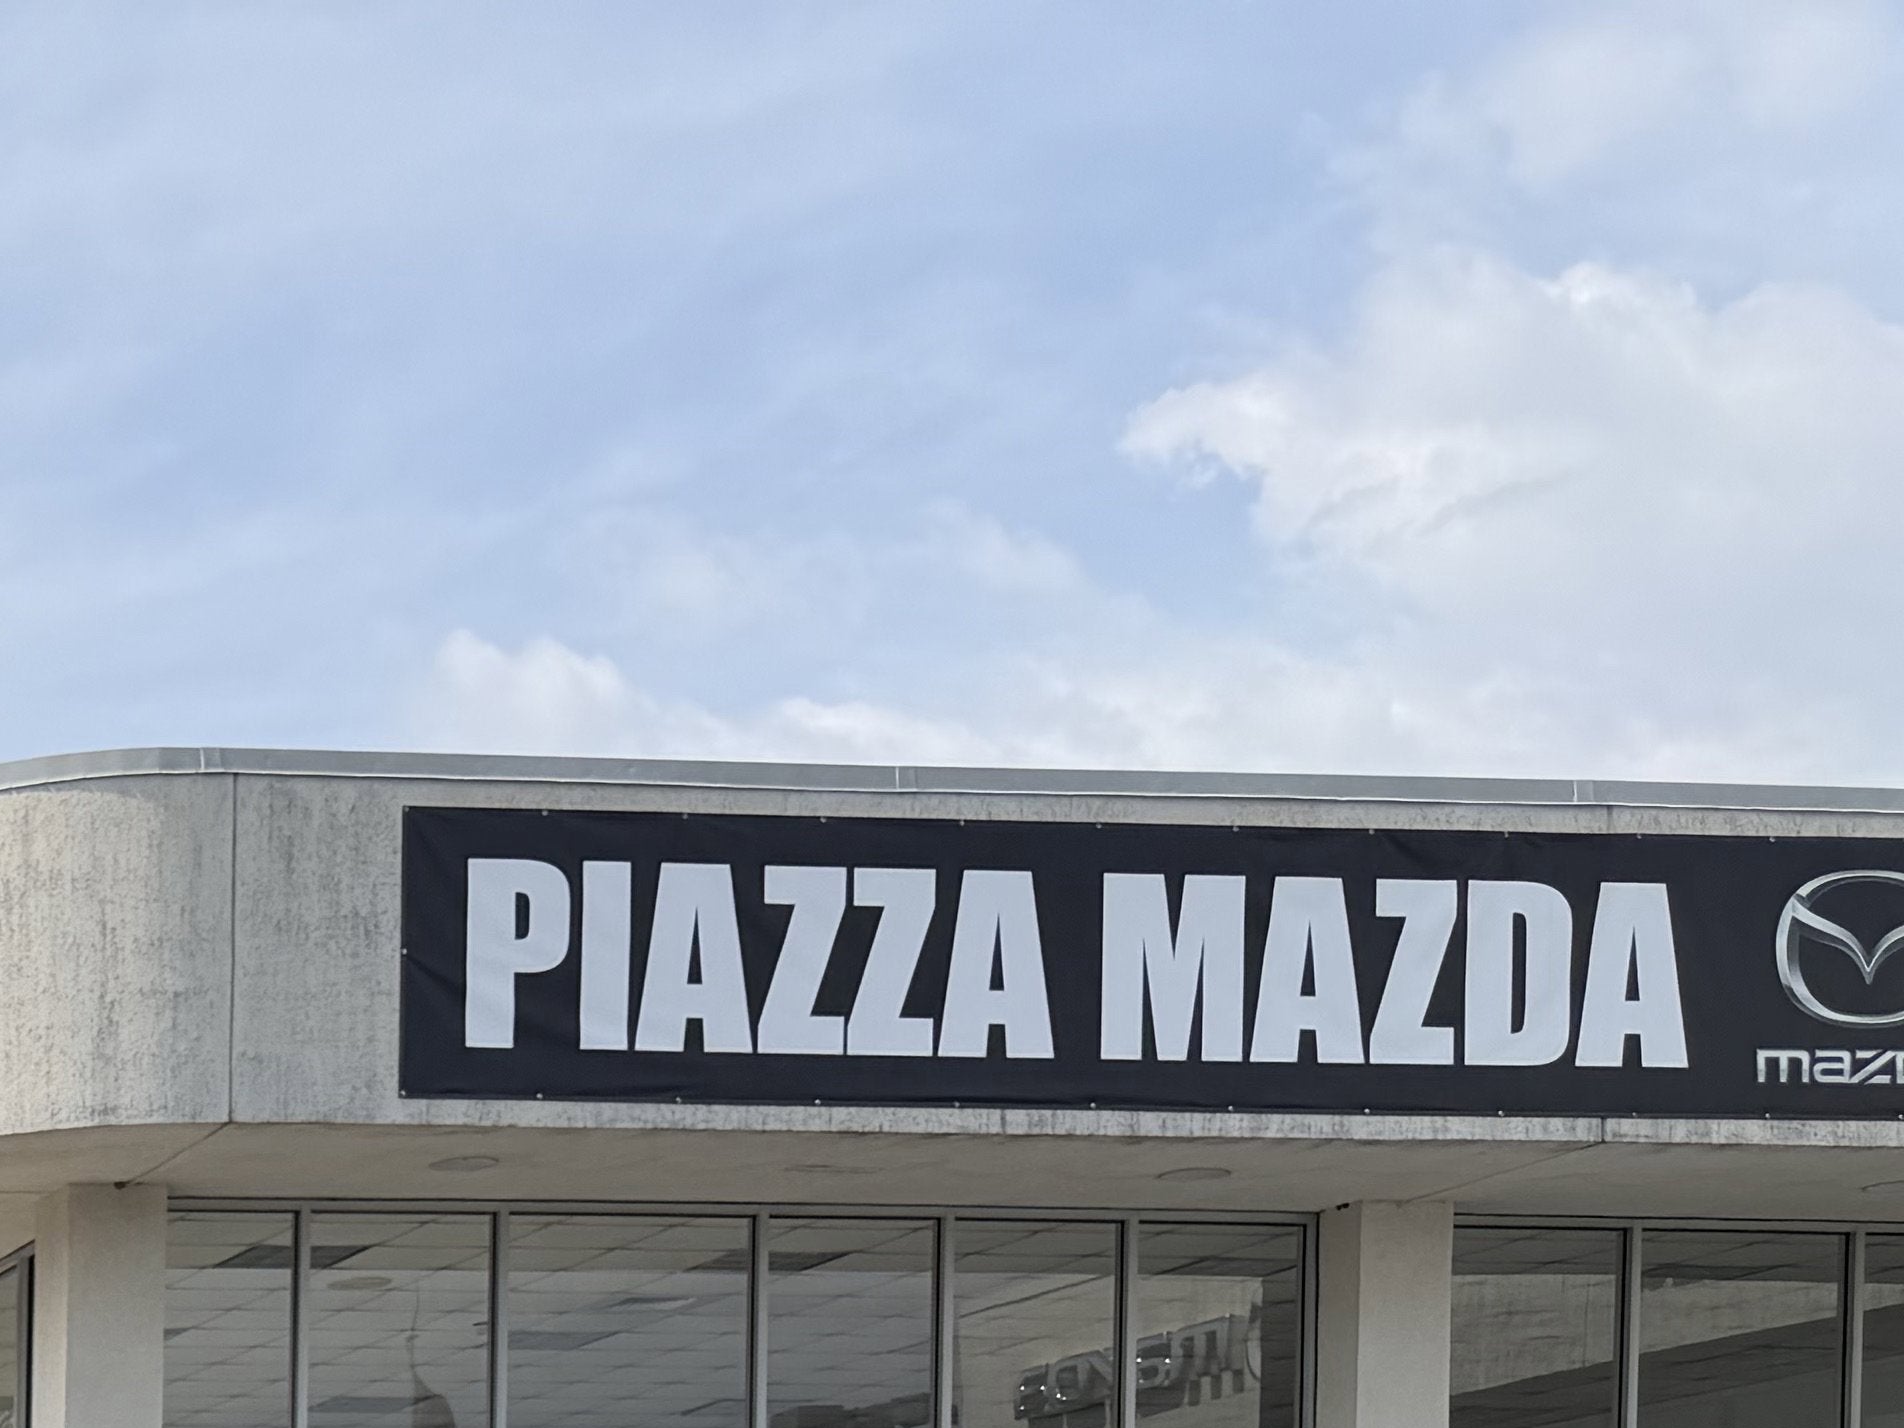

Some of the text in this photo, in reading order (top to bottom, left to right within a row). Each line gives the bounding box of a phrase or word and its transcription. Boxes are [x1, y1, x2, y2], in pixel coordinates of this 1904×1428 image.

[464, 858, 1689, 1068] PIAZZA MAZDA
[1756, 1048, 1904, 1084] maz
